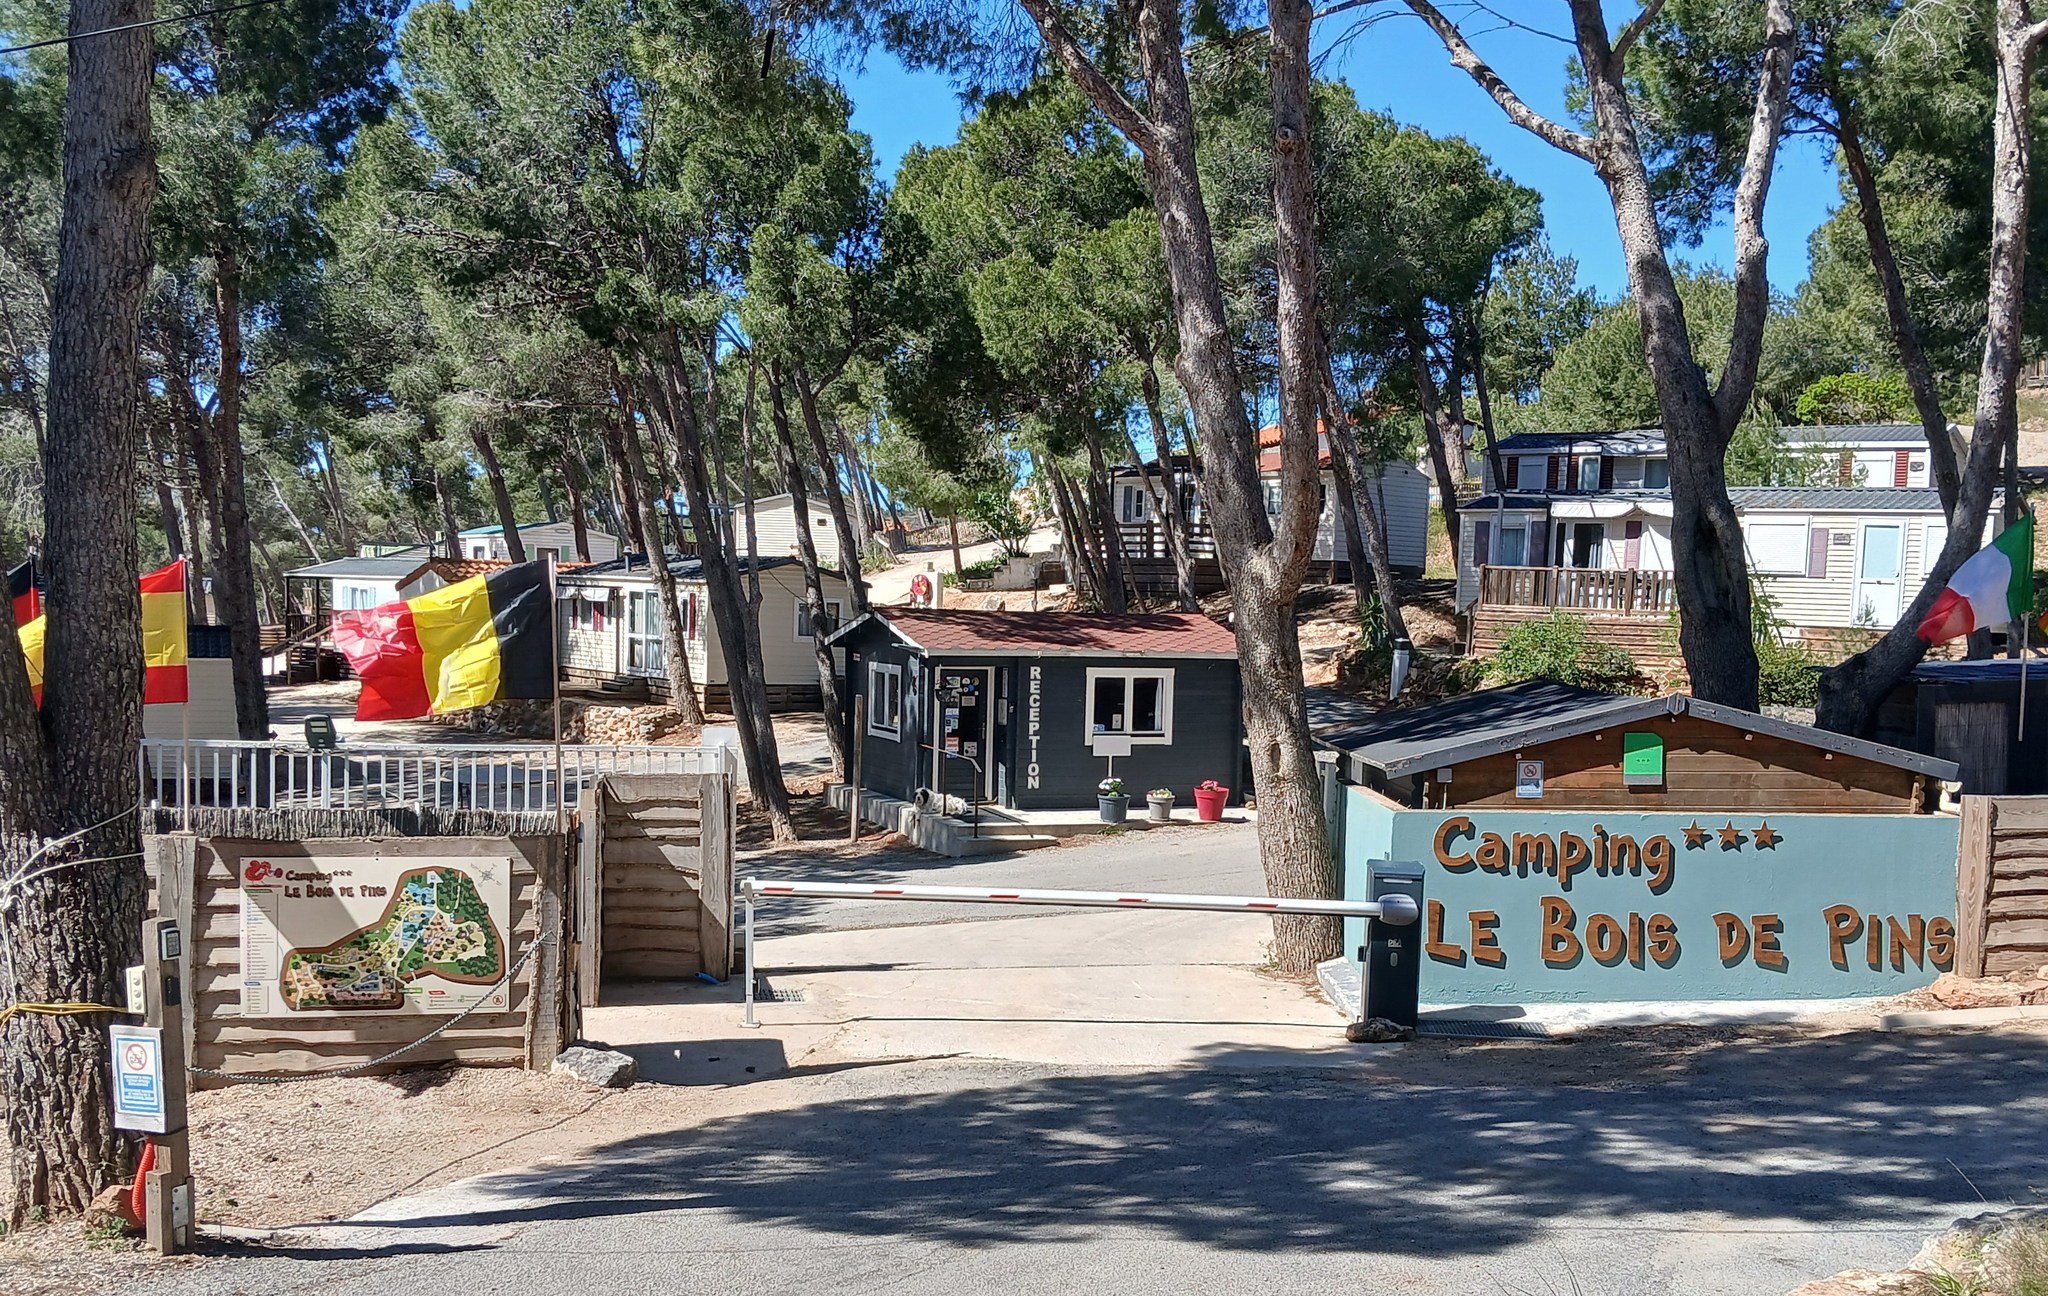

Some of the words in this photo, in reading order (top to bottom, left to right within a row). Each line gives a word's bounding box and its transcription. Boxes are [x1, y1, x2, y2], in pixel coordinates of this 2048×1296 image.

[1027, 666, 1041, 789] RECEPTION
[284, 885, 301, 898] LE
[306, 884, 334, 898] BOIS
[339, 886, 354, 898] DE
[360, 885, 387, 897] PINS
[285, 870, 333, 884] Camping
[1433, 816, 1674, 892] Camping
[1425, 898, 1504, 967] LE
[1540, 896, 1681, 968] BOIS
[1712, 912, 1787, 972] DE
[1822, 903, 1956, 972] PINS
